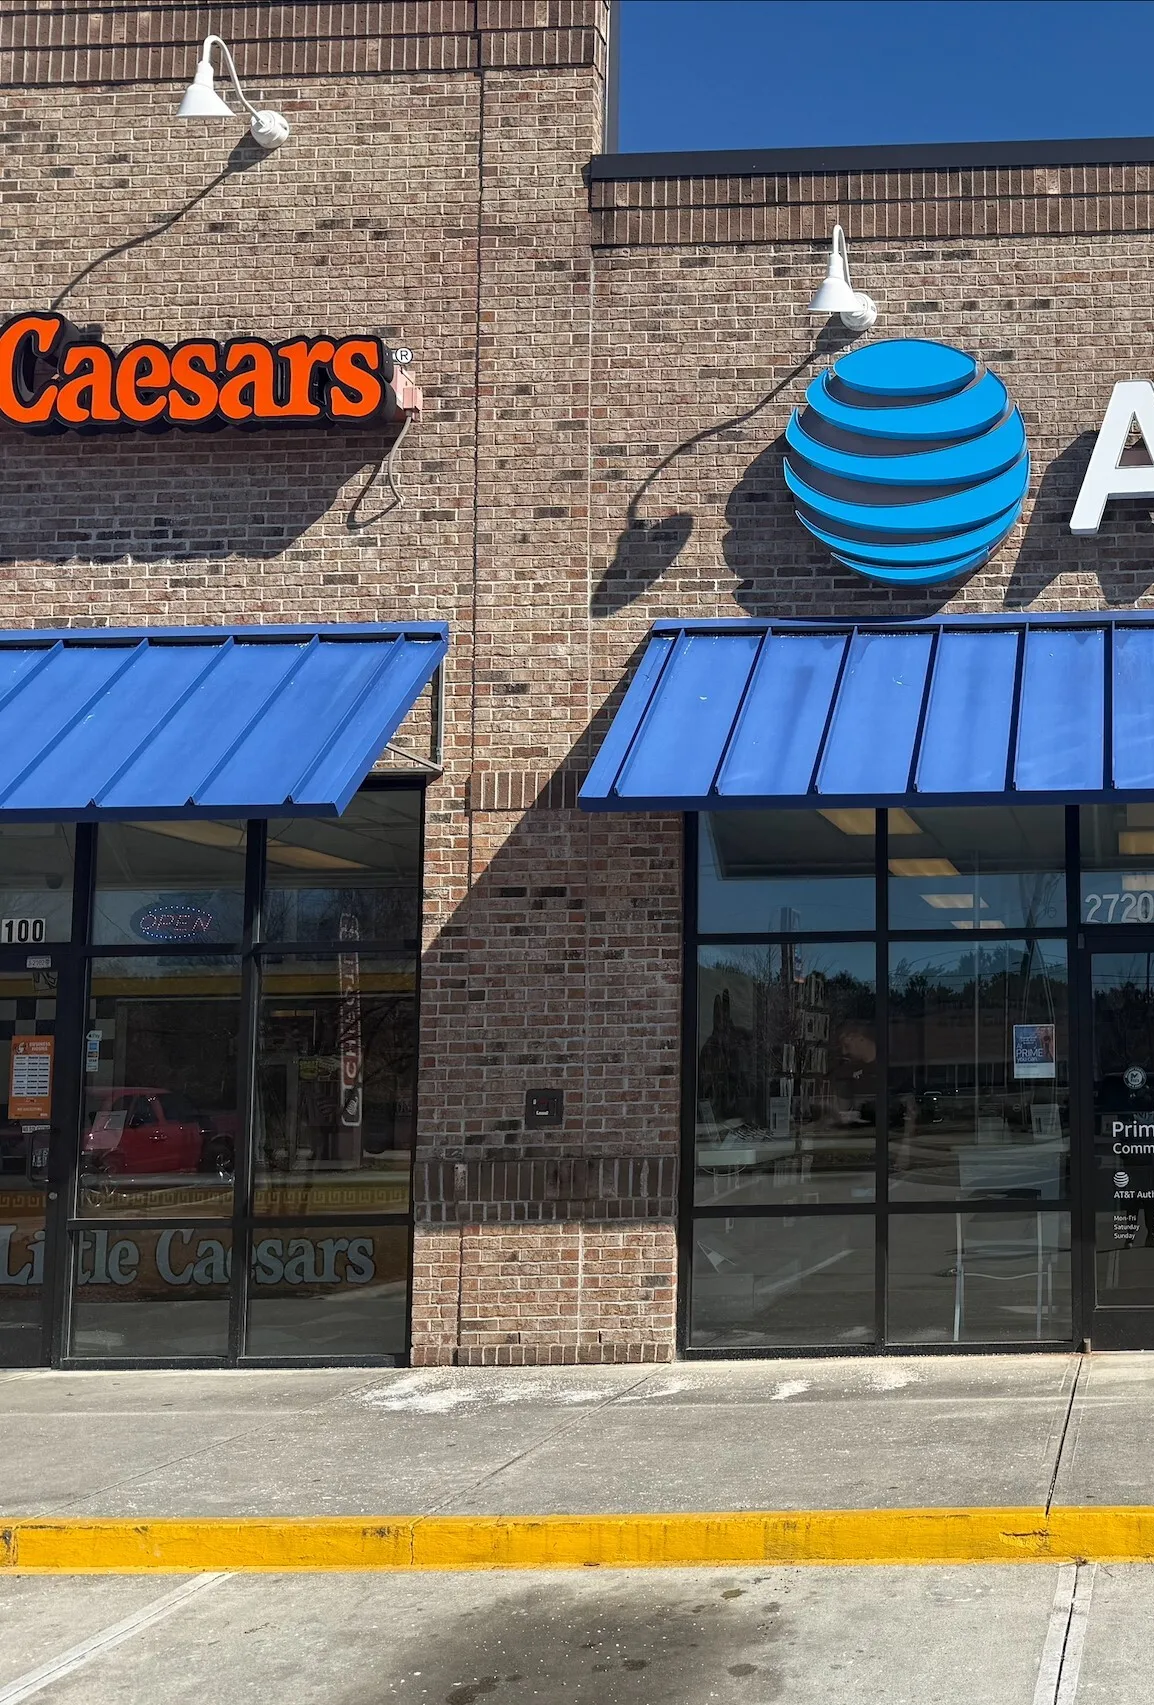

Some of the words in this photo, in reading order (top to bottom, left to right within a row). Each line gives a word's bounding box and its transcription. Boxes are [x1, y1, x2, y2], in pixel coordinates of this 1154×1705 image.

[0, 314, 386, 424] Caesars
[1085, 892, 1154, 923] 2720
[4, 919, 45, 942] 100
[140, 914, 213, 931] OPEN
[1016, 1048, 1043, 1058] PRIME
[1113, 1190, 1136, 1199] AT&T
[1113, 1223, 1140, 1231] Saturday
[1113, 1232, 1136, 1240] Sunday
[0, 1225, 140, 1286] Litle
